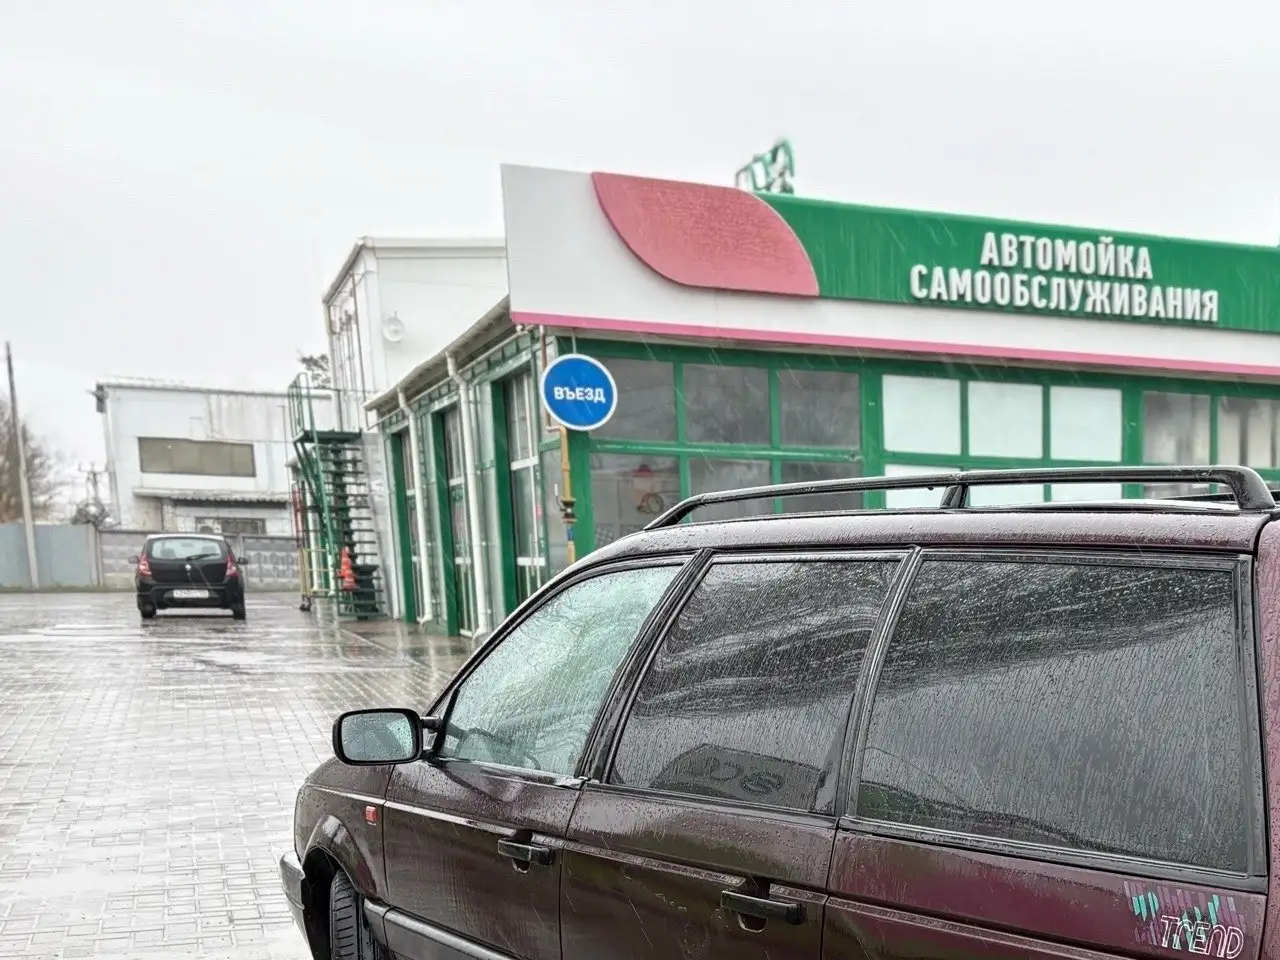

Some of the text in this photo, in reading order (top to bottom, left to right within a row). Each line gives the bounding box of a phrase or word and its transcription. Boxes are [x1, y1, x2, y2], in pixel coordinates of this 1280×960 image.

[980, 231, 1154, 280] АВТОМОЙКА
[909, 263, 1219, 322] САМООБСЛУЖИВАНИЯ
[553, 386, 606, 404] ВЪЕЗД
[1161, 915, 1245, 960] TREND
